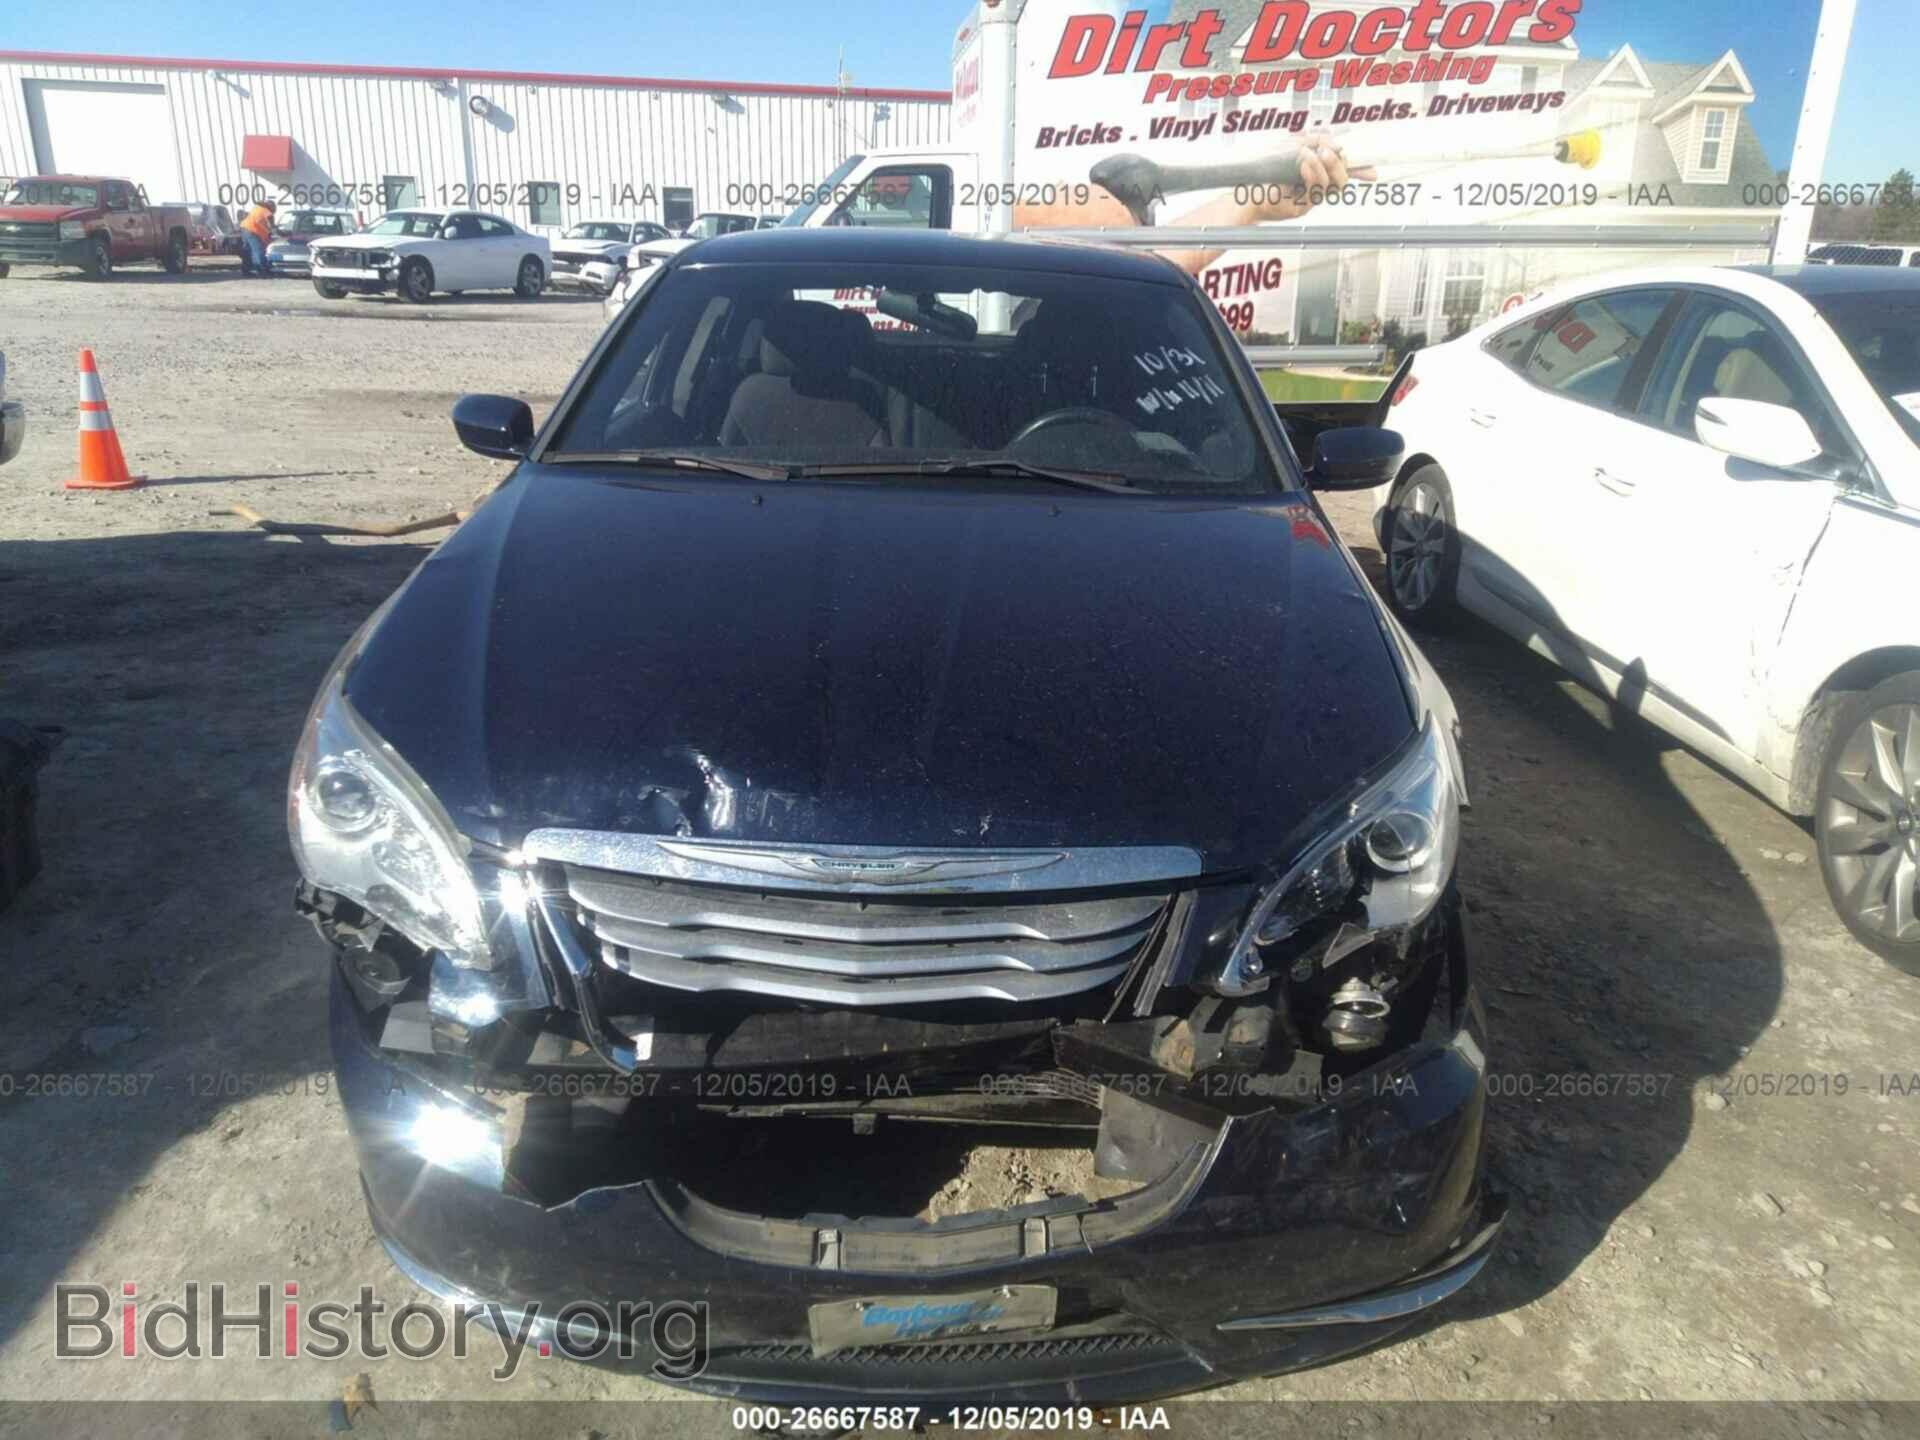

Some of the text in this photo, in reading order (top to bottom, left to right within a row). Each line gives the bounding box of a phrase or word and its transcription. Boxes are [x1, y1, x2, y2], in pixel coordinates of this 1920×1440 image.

[1048, 10, 1225, 80] Dirt
[1241, 0, 1582, 64] Doctors
[1142, 53, 1498, 105] Pressure Washing
[1035, 123, 1124, 149] Bricks
[1148, 112, 1218, 142] Vinyl
[1222, 108, 1309, 133] Siding
[1426, 90, 1566, 119] Driveways
[1194, 257, 1283, 300] RTING
[1133, 345, 1207, 375] 10/31
